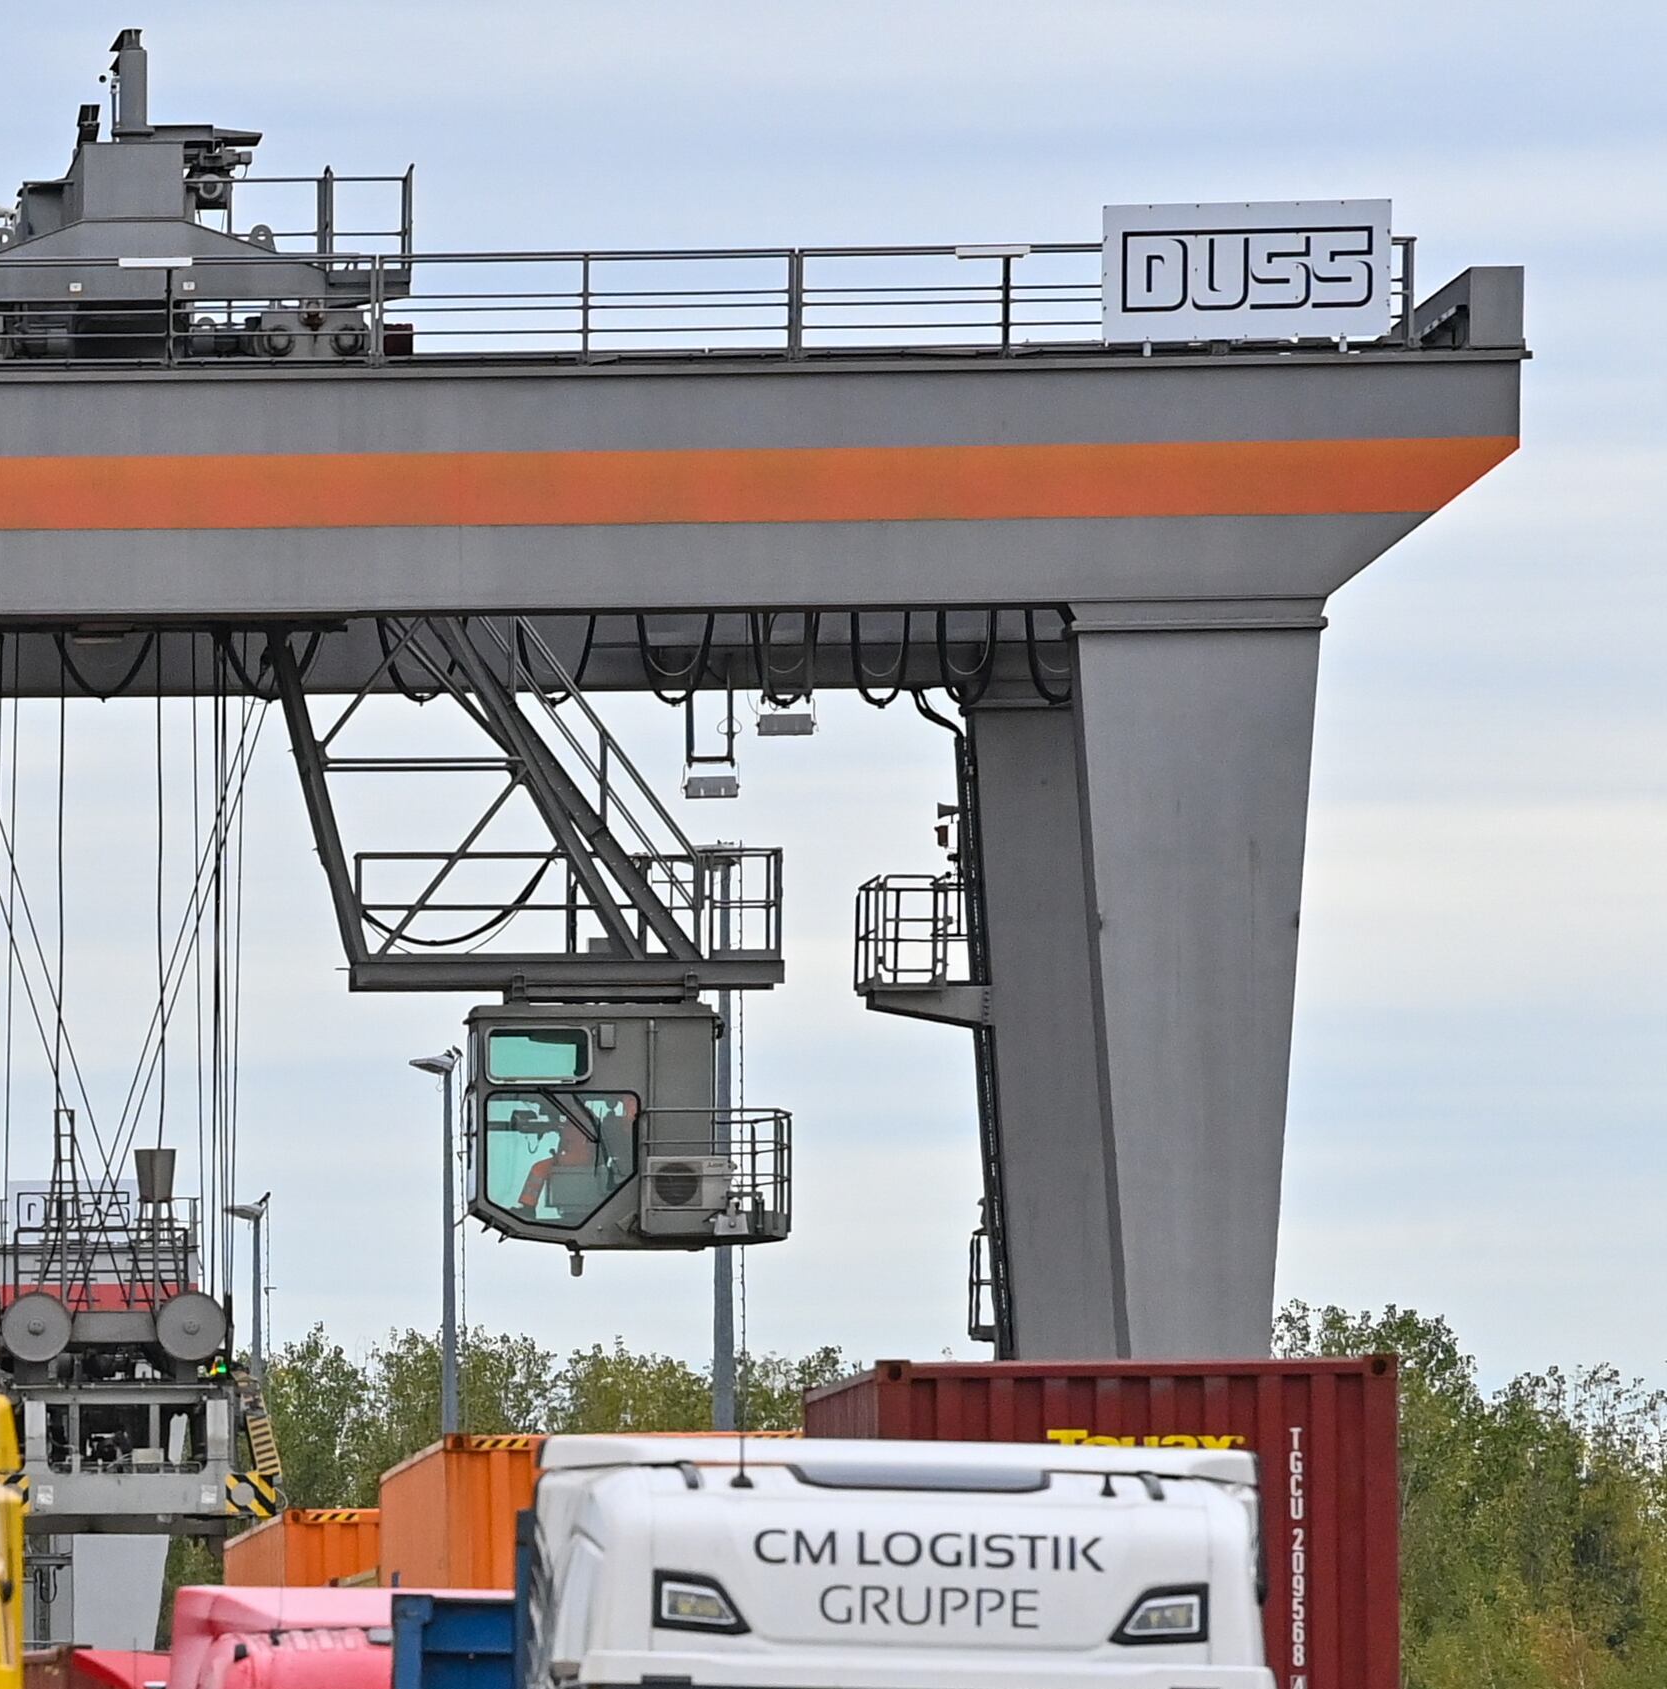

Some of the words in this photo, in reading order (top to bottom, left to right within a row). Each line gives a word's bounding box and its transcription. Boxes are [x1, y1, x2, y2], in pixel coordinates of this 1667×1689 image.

[1121, 225, 1374, 313] DUSS
[1289, 1427, 1304, 1520] TGCU
[754, 1529, 837, 1566] CM
[857, 1531, 1105, 1573] LOGISTIK
[820, 1584, 1040, 1629] GRUPPE
[1291, 1528, 1306, 1667] 209568
